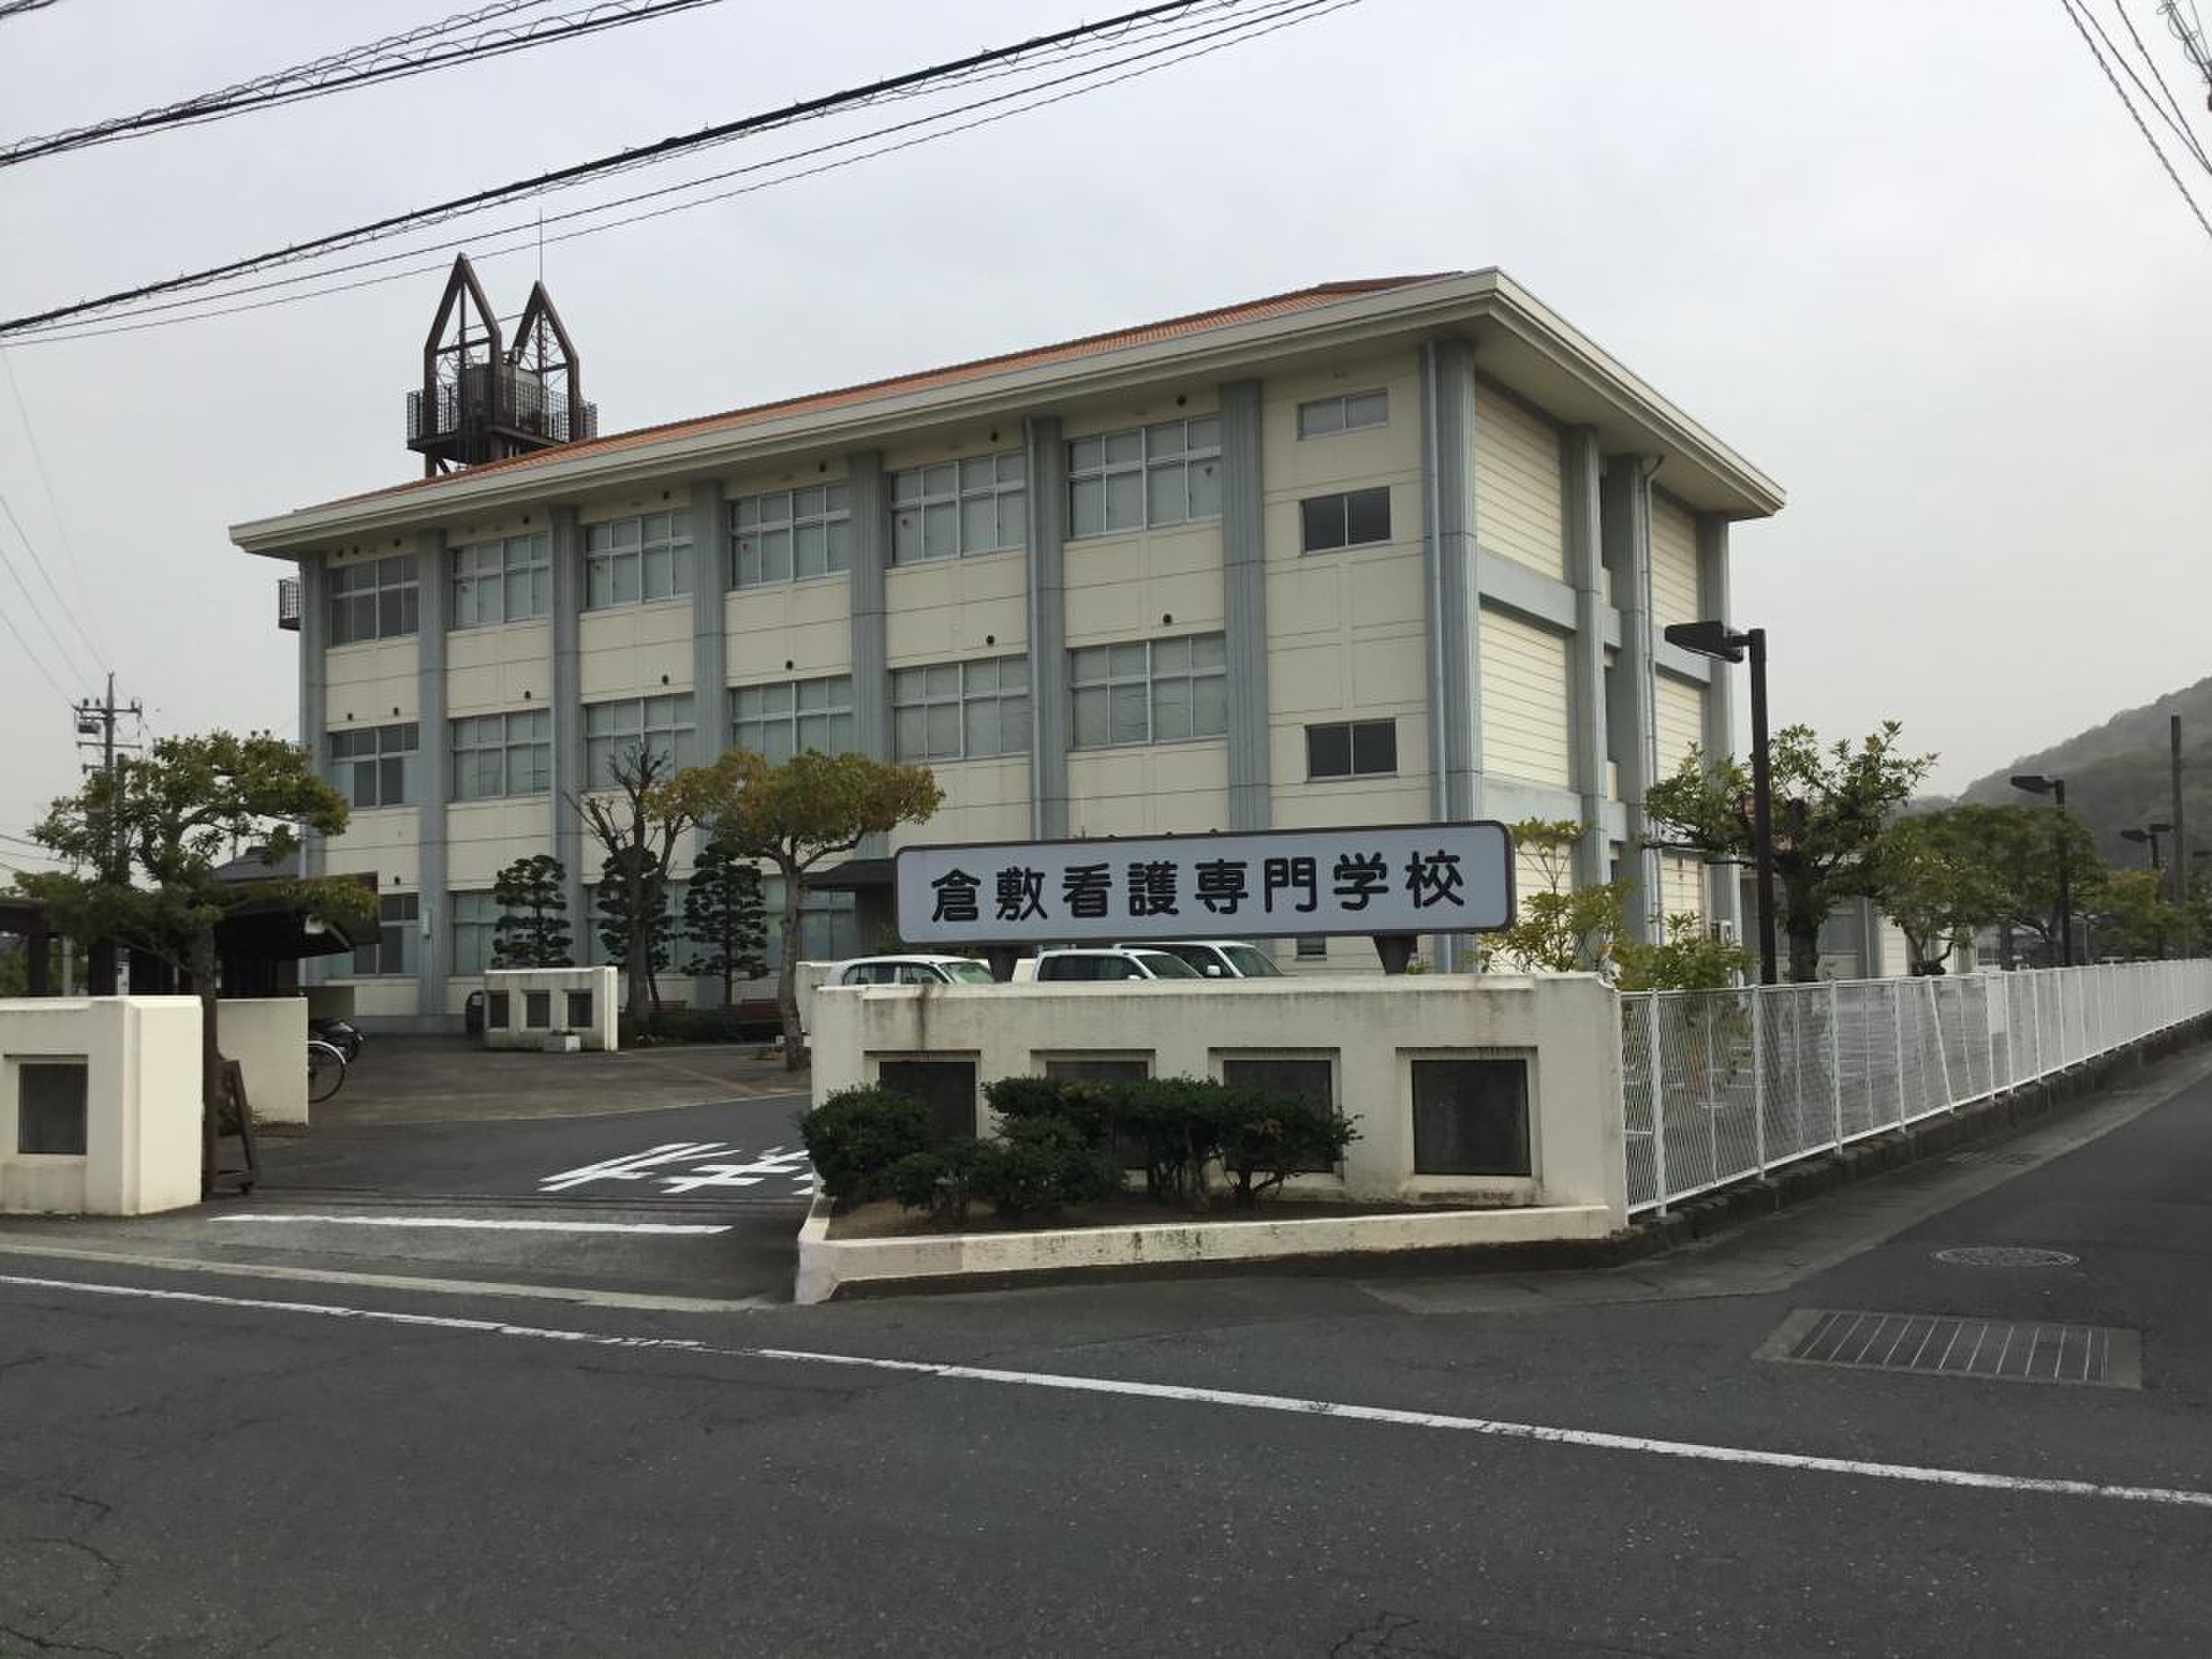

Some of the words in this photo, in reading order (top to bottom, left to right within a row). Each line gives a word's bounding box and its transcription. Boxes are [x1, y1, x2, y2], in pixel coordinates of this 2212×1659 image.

[930, 850, 1465, 923] 倉敷看護専門学校
[537, 1142, 813, 1194] まれ
